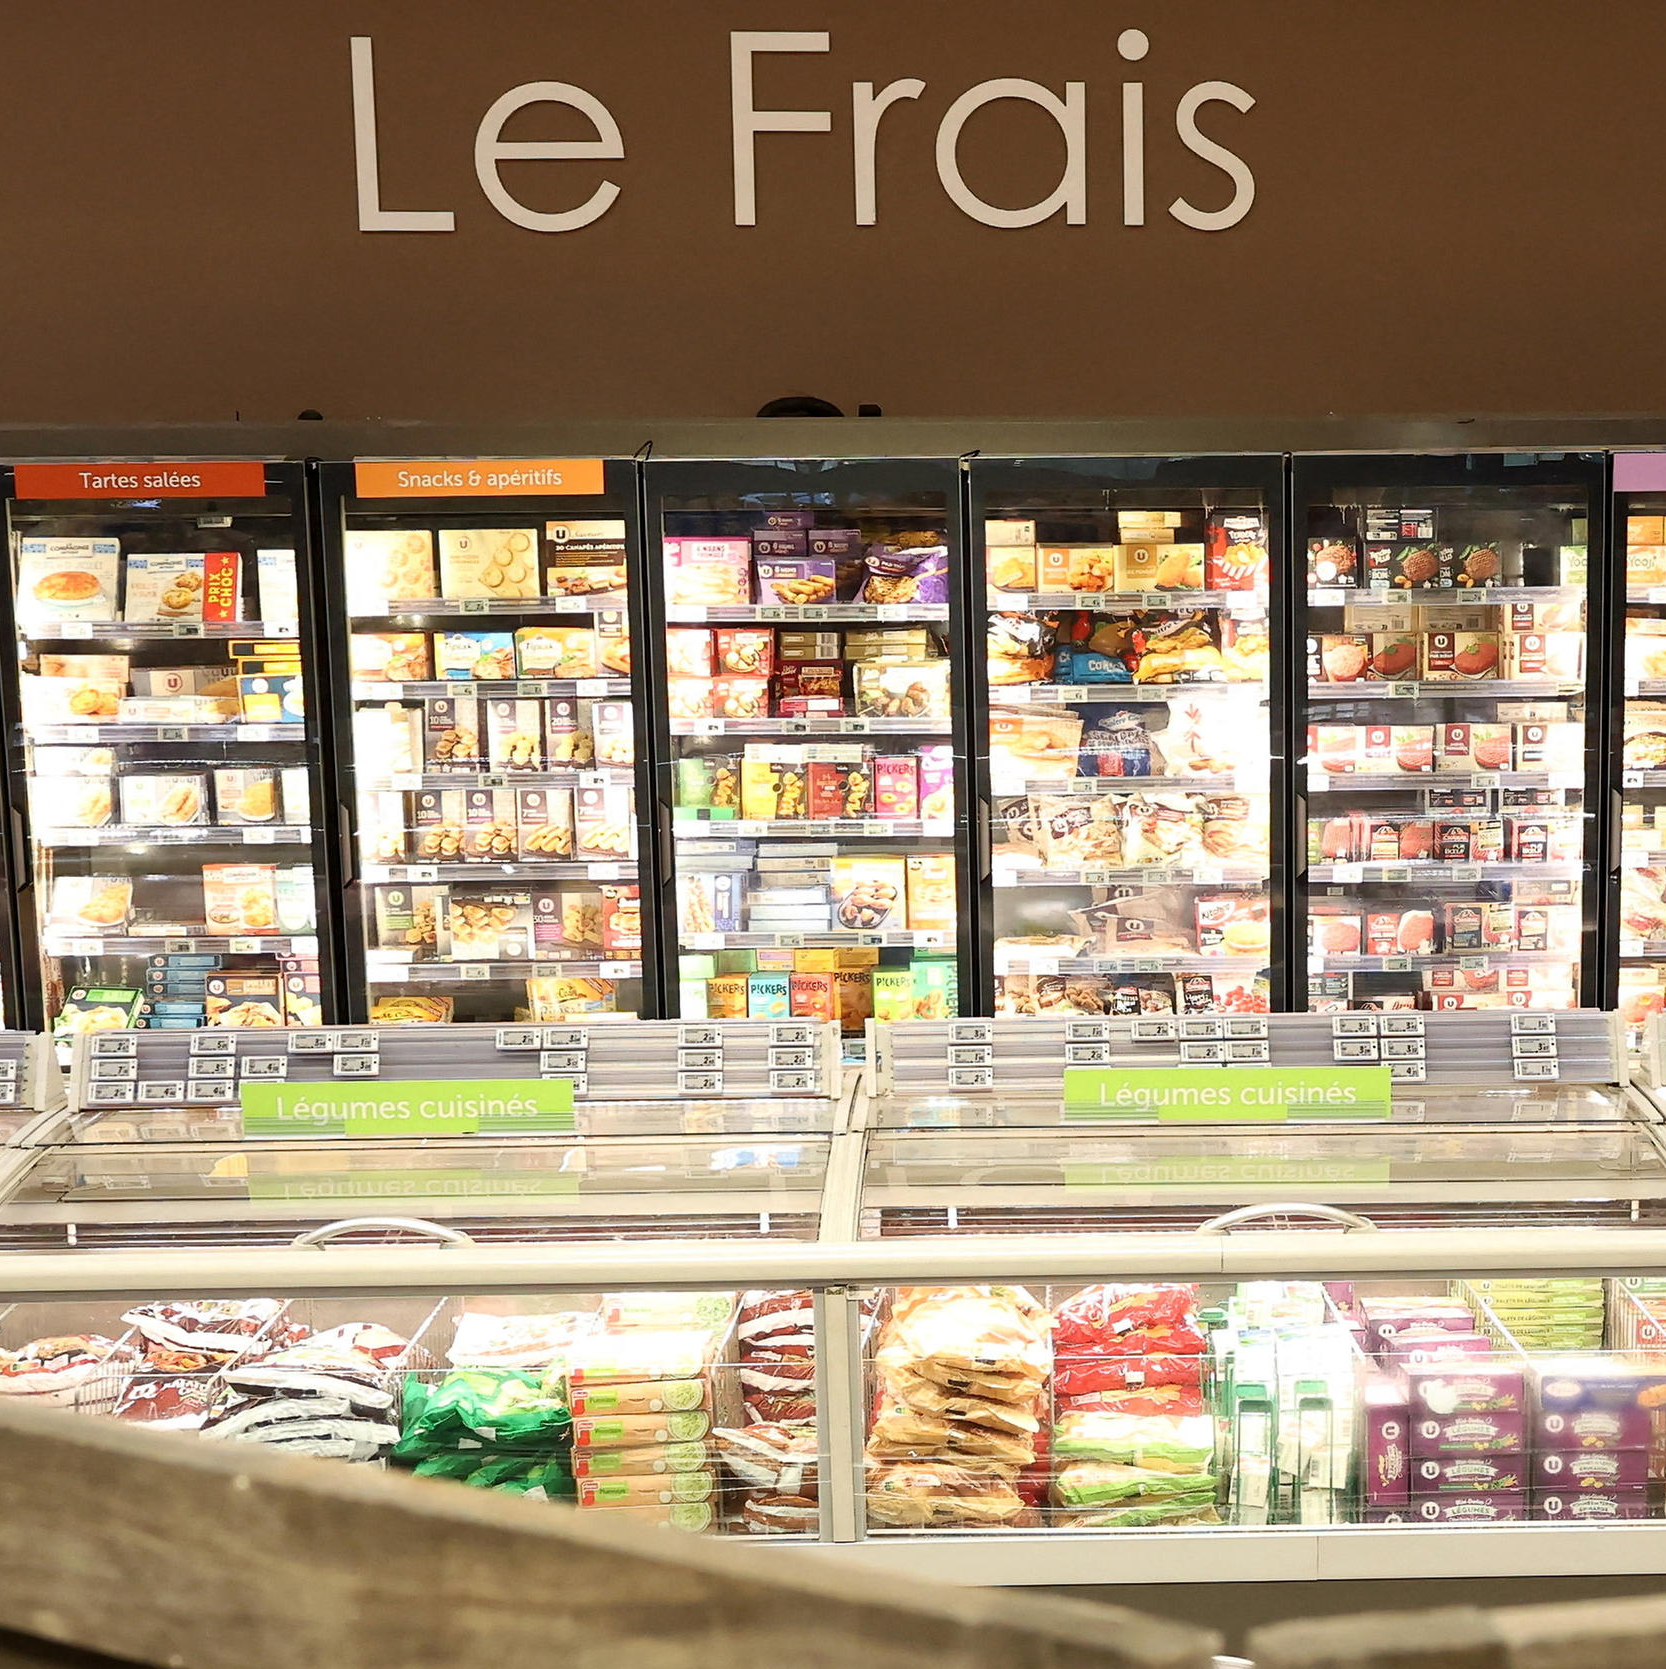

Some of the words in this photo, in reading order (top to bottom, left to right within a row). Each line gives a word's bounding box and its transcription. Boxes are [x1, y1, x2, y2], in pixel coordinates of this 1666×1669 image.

[350, 35, 625, 232] Le
[730, 28, 1257, 232] Frais
[79, 472, 138, 489] Tartes
[143, 471, 201, 488] salées
[397, 470, 463, 487] Snacks
[468, 469, 482, 486] &
[486, 468, 563, 489] apéritifs
[208, 572, 220, 603] PRIX
[221, 567, 233, 608] CHOC
[276, 1094, 411, 1126] Légumes
[419, 1093, 538, 1119] cuisinés
[1099, 1081, 1232, 1113] Légumes
[1240, 1080, 1357, 1105] cuisinés
